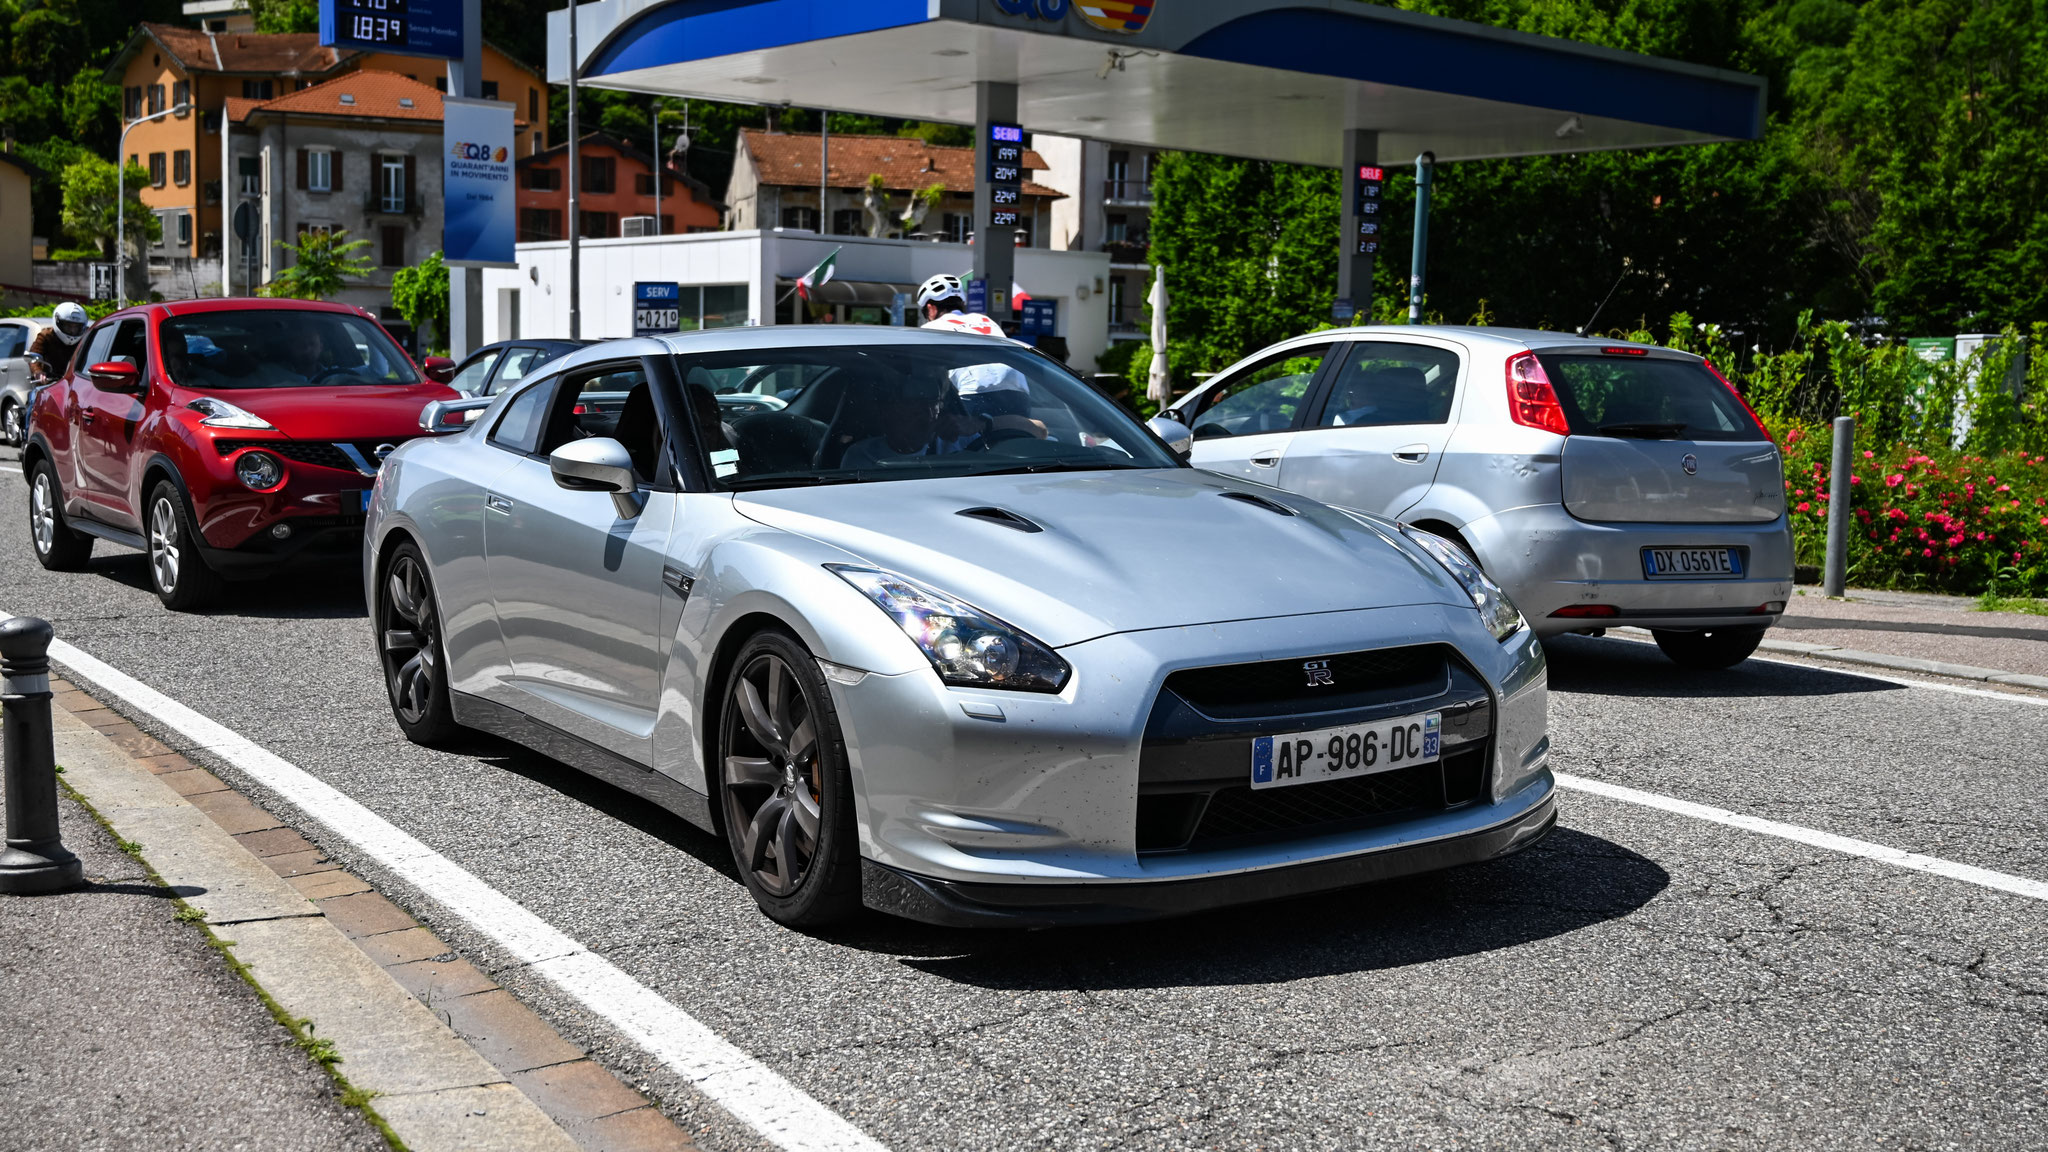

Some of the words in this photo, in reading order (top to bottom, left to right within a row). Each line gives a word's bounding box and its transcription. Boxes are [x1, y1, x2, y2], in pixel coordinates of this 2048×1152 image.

[451, 161, 509, 173] QUARANT'ANNI
[462, 171, 509, 181] MOVIMENTO
[1361, 167, 1381, 180] SELF
[646, 287, 670, 298] SERV
[1654, 550, 1677, 572] DX
[1681, 550, 1731, 572] 056YE
[1303, 659, 1331, 670] GT
[1304, 669, 1335, 687] R
[1259, 764, 1266, 776] F
[1276, 723, 1421, 780] AP-986-DC
[1424, 737, 1438, 754] 33
